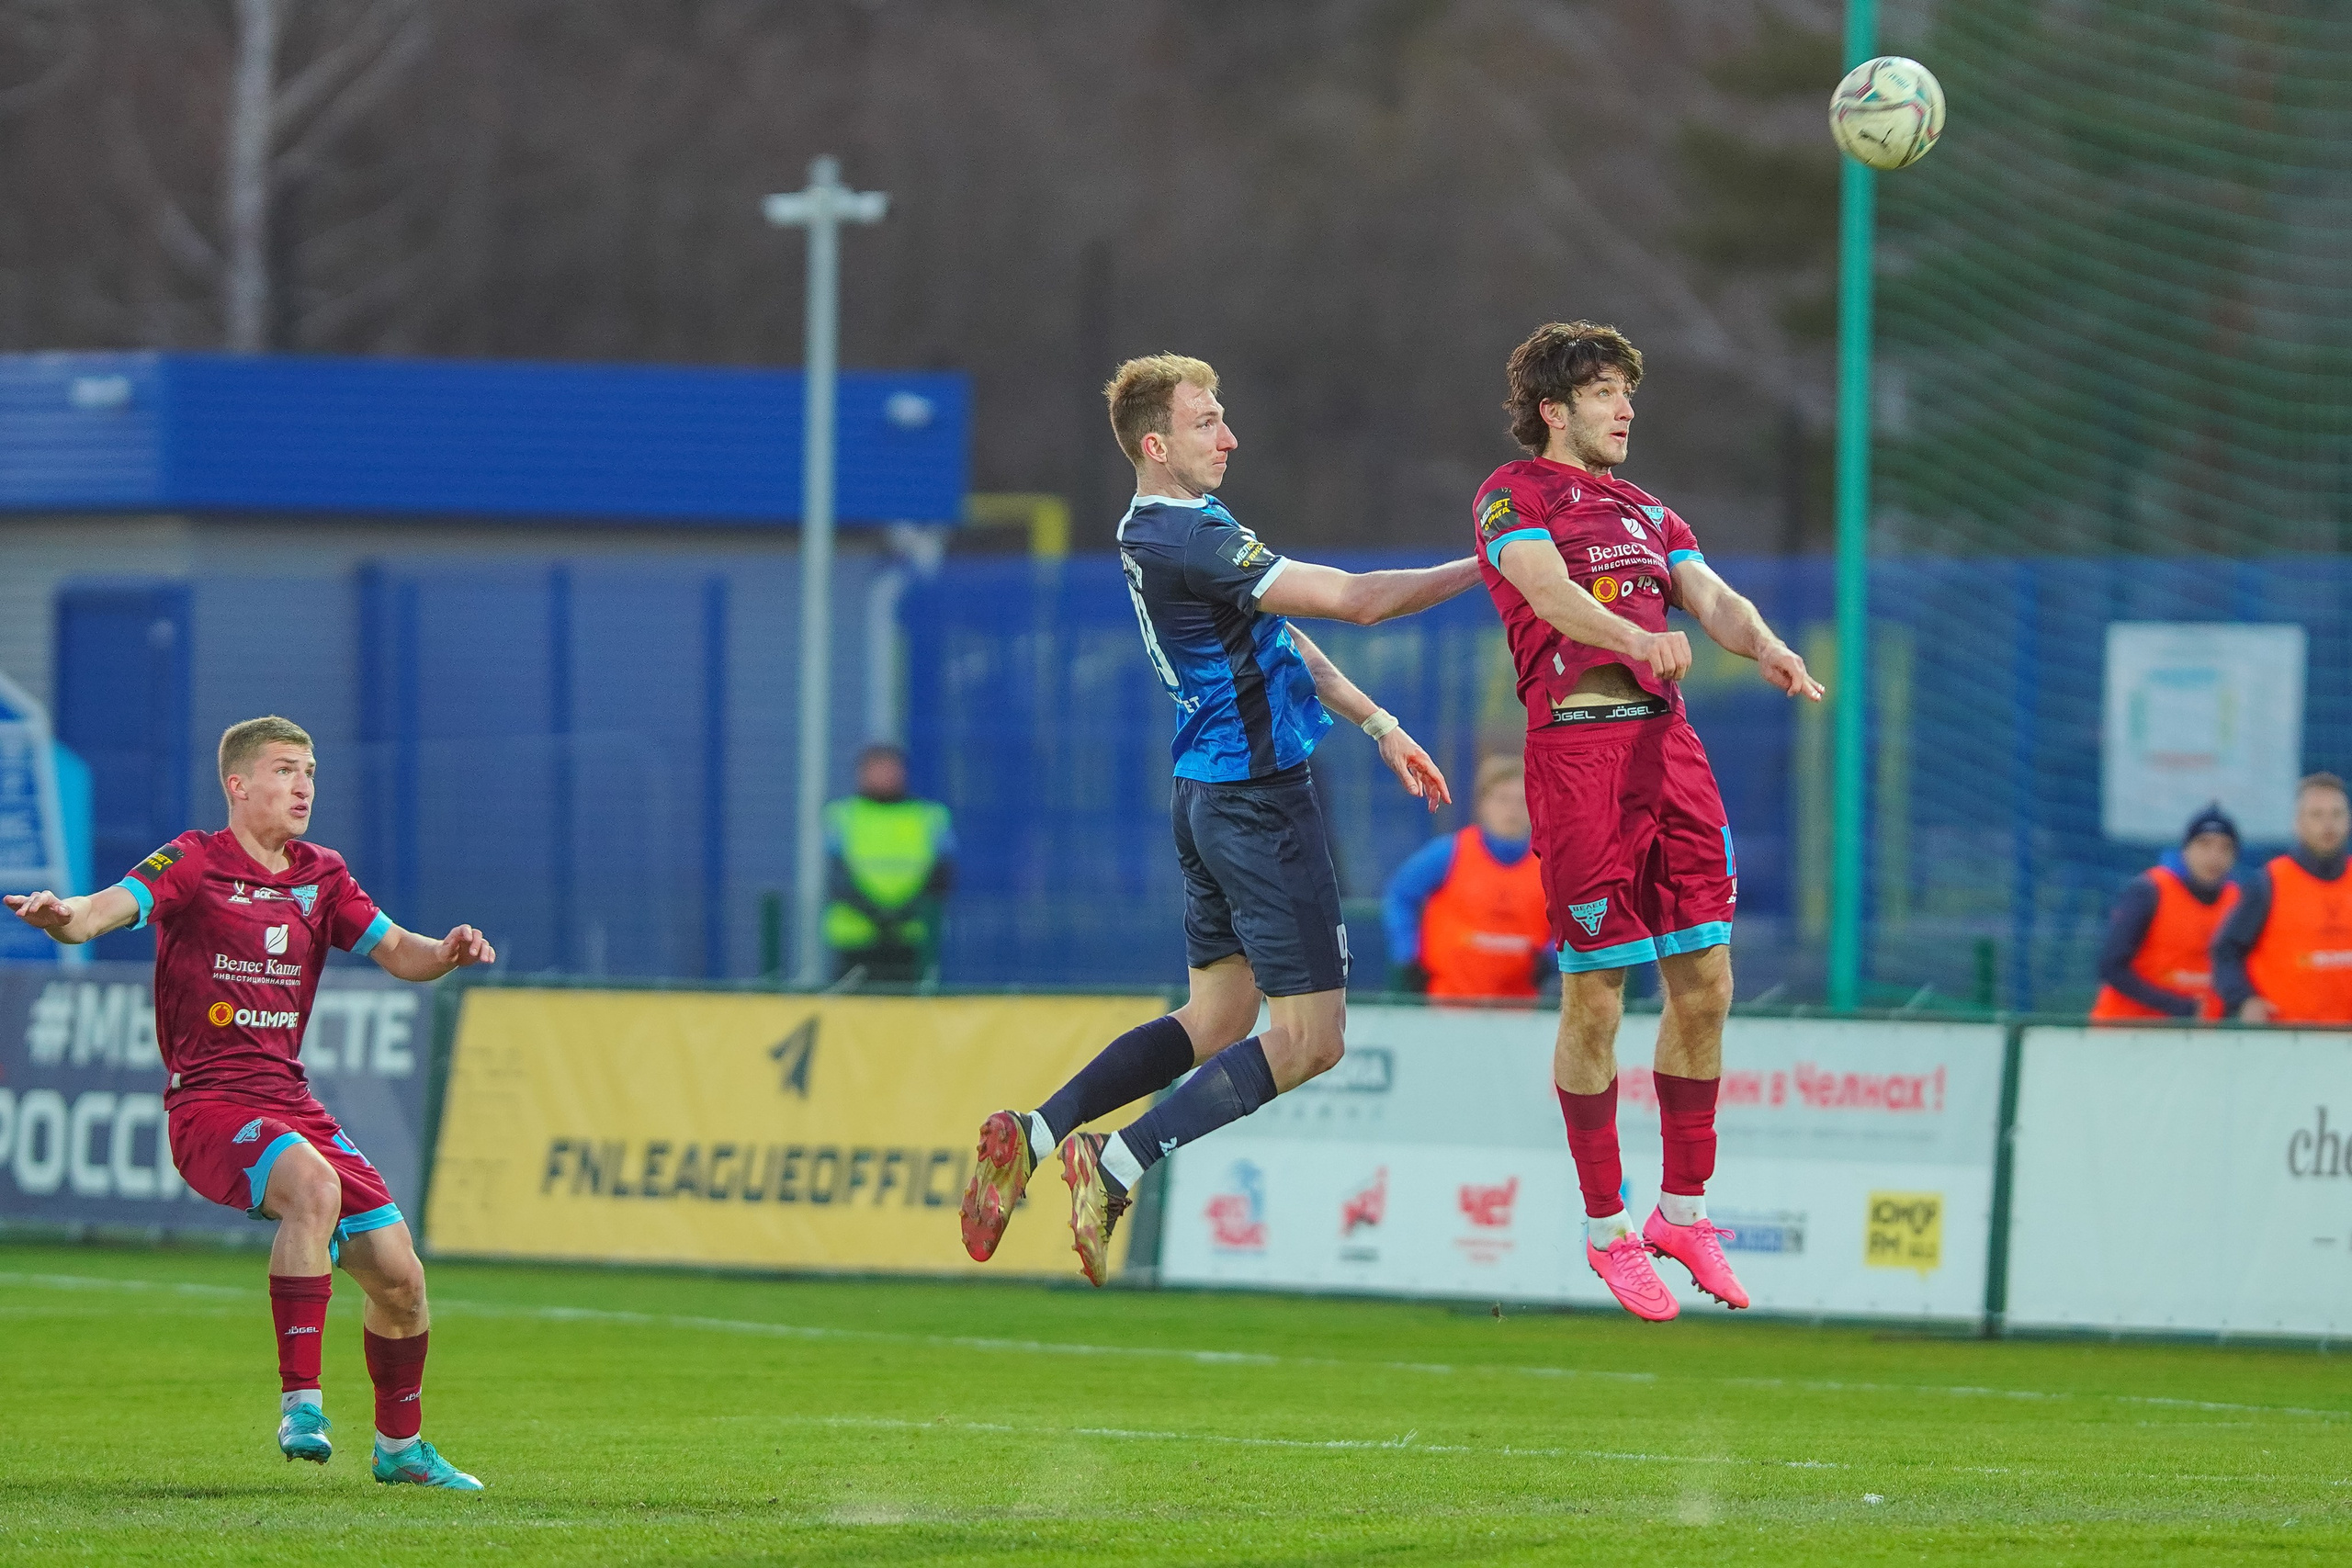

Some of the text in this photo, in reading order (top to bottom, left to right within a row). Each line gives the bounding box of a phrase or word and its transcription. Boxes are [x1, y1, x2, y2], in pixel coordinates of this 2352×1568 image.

[1232, 541, 1259, 566] МЕЛБ
[1587, 543, 1641, 564] Велес
[1552, 710, 1597, 723] ÖGEL
[1605, 705, 1655, 718] JÖGEL
[214, 953, 264, 974] Велес
[213, 972, 285, 986] ИНВЕСТИЦИОННАЯ
[540, 1137, 1029, 1213] FNLEAGUEOFFICI
[284, 1325, 320, 1336] JÖGEL
